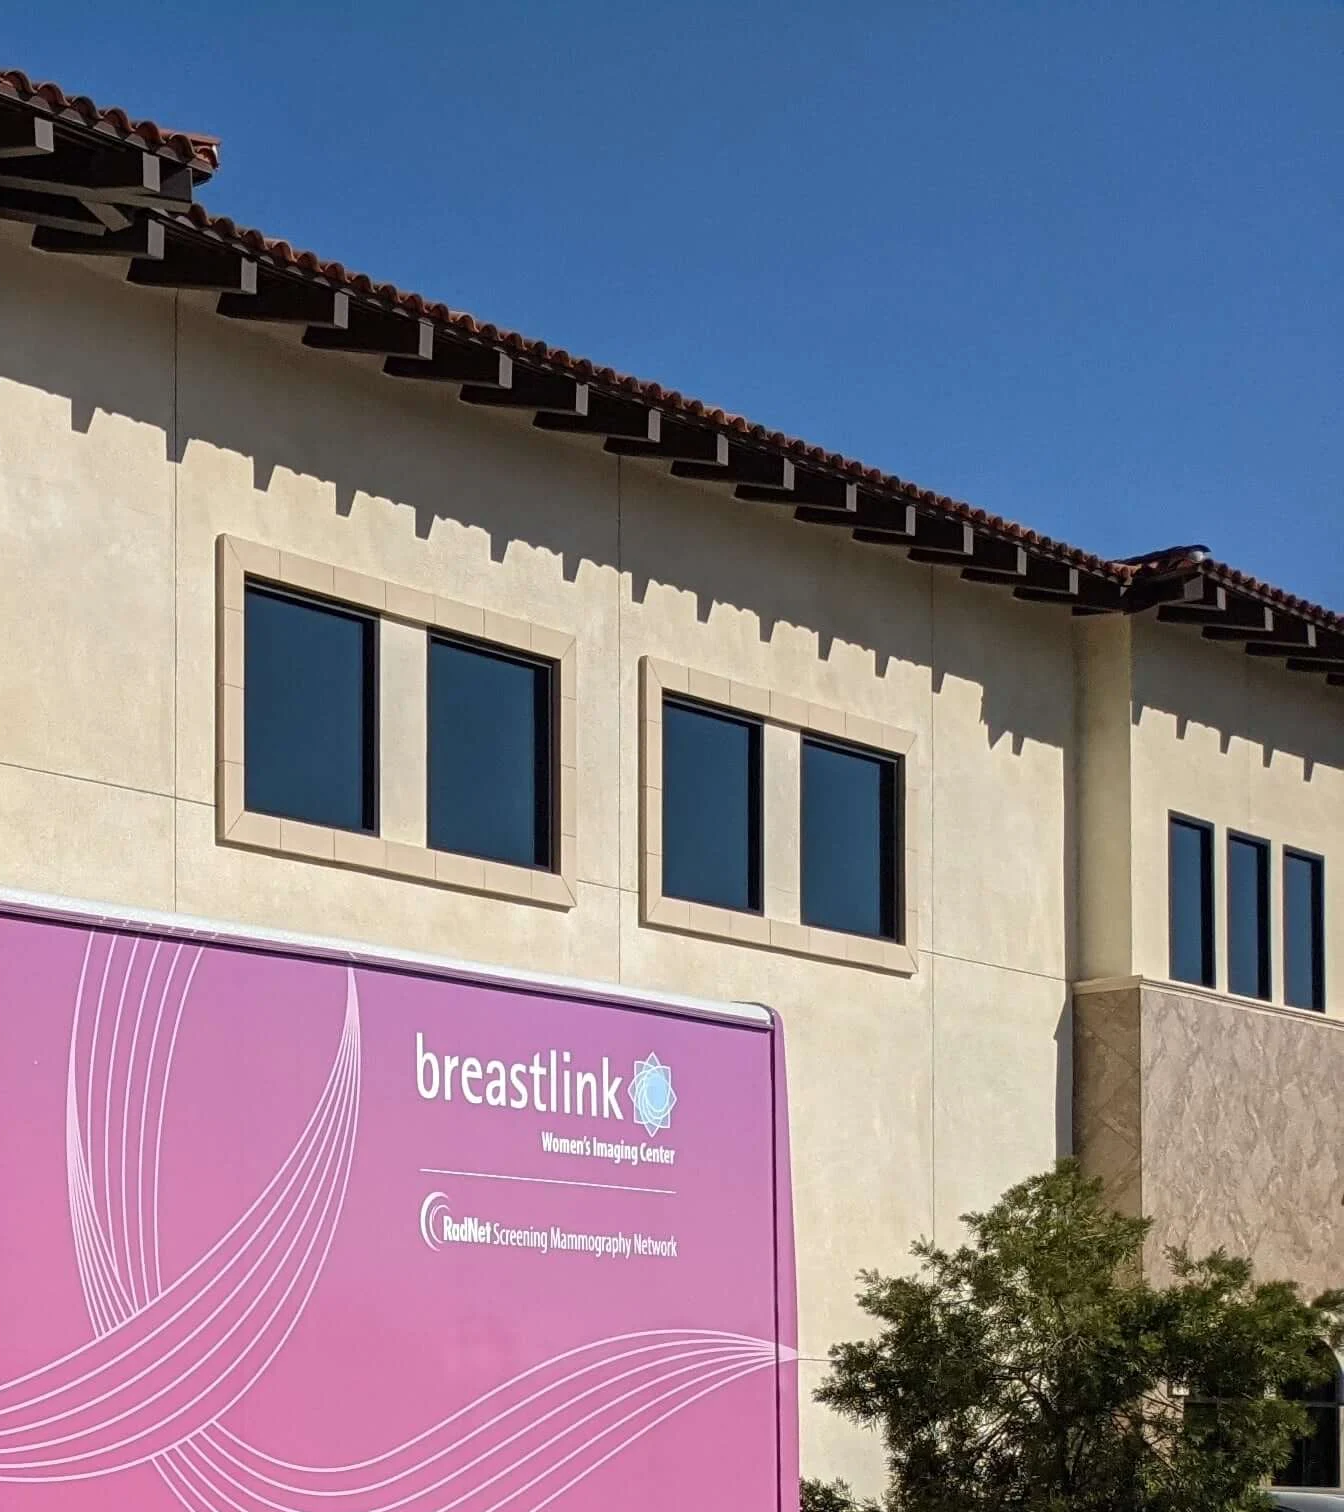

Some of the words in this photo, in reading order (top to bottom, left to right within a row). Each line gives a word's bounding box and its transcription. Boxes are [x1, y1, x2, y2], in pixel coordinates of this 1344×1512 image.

[416, 1032, 624, 1120] breastlink
[541, 1131, 591, 1156] Women's
[593, 1137, 638, 1165] Imaging
[640, 1142, 675, 1165] Center
[443, 1215, 492, 1244] RadNet
[493, 1223, 548, 1253] Screening
[550, 1227, 632, 1259] Mammography
[633, 1233, 678, 1257] Network
